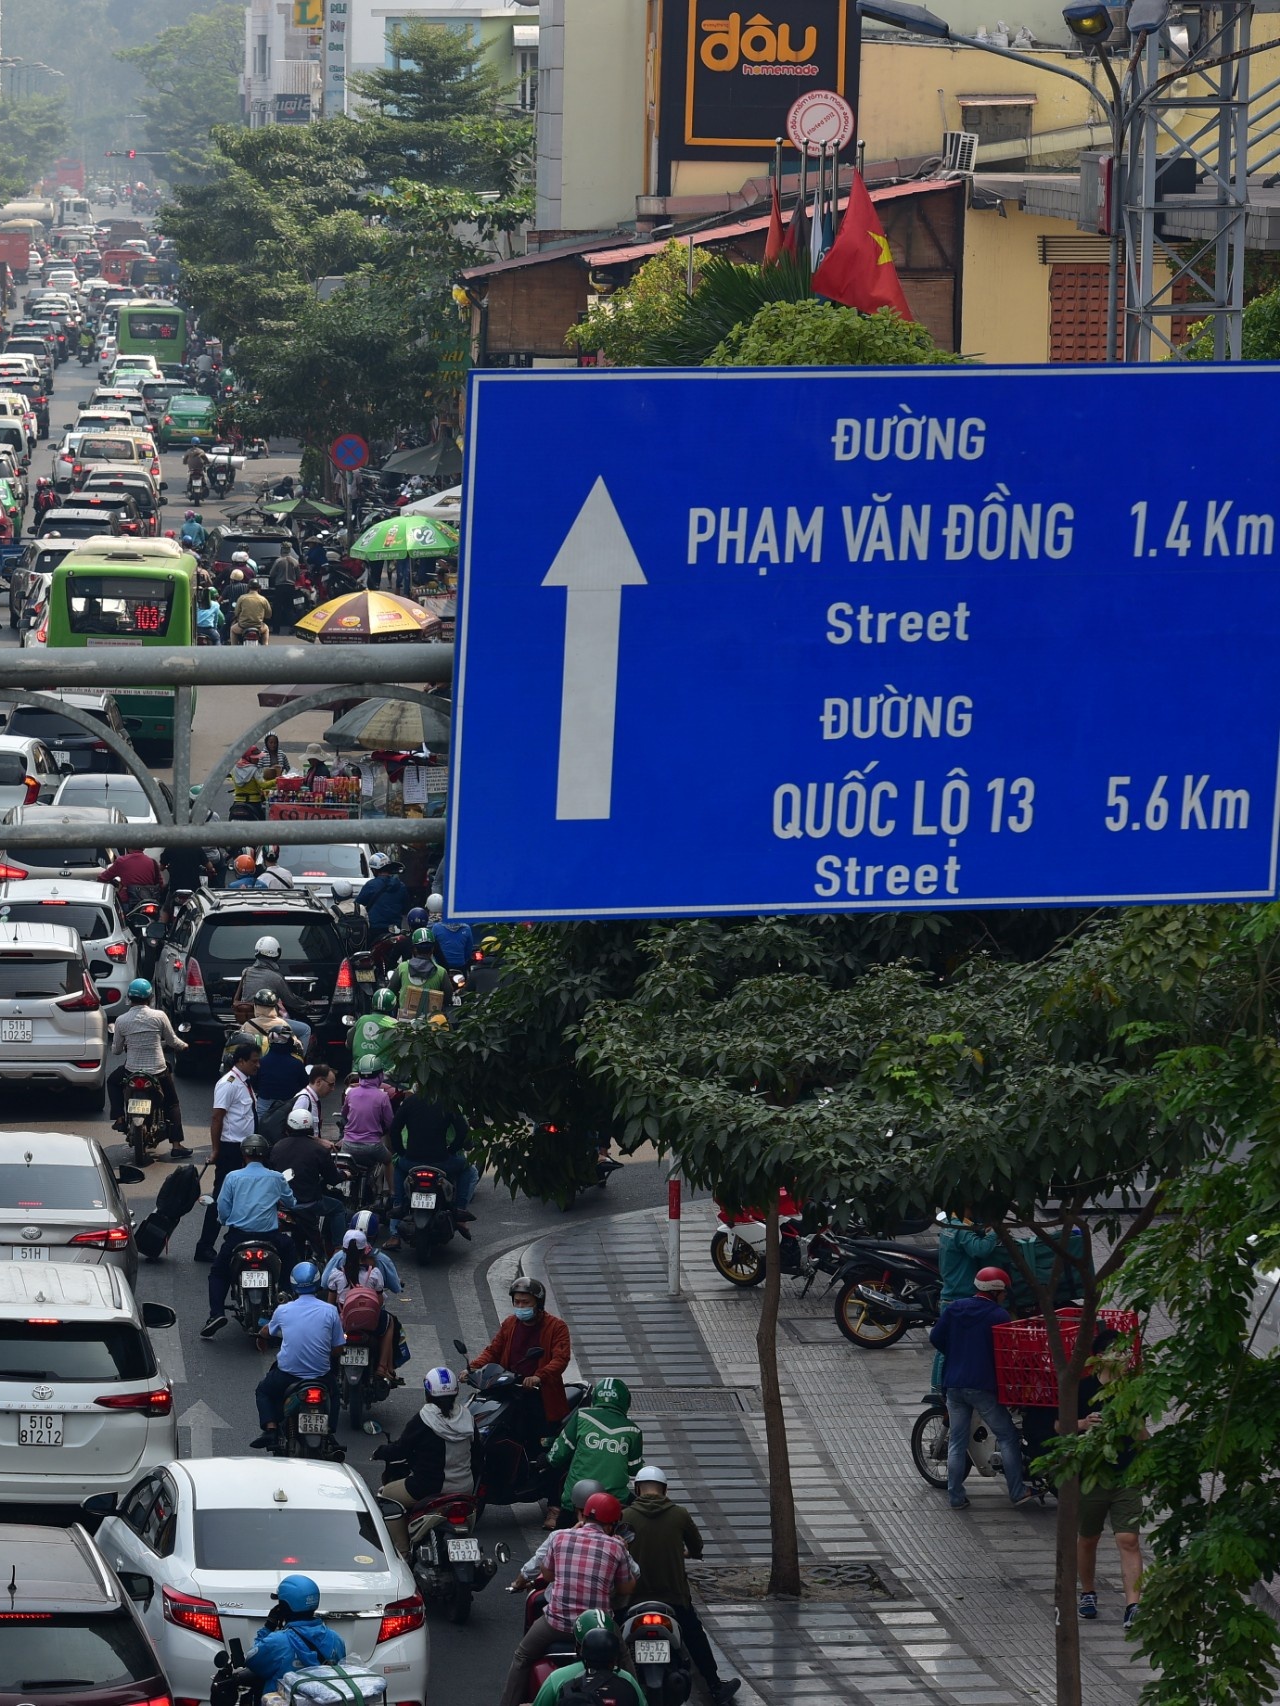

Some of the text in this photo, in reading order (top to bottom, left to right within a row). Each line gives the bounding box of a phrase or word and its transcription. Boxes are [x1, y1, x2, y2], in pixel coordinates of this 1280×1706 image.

[743, 64, 819, 75] homemade
[832, 405, 986, 461] ĐƯỜNG
[687, 483, 1274, 576] PHẠM VĂN ĐỒNG 1.4 Km
[135, 606, 158, 629] 103
[827, 602, 970, 644] Street
[819, 684, 973, 740] ĐƯỜNG
[773, 761, 1249, 847] QUỐC LỘ 13 5.6 Km
[814, 855, 961, 897] Street
[8, 1021, 26, 1030] 51H
[21, 1245, 41, 1260] 51H
[597, 1389, 617, 1398] Grab
[29, 1415, 53, 1429] 51G
[20, 1429, 62, 1444] 812.12
[584, 1431, 630, 1455] Grab
[636, 1651, 669, 1663] 175.77
